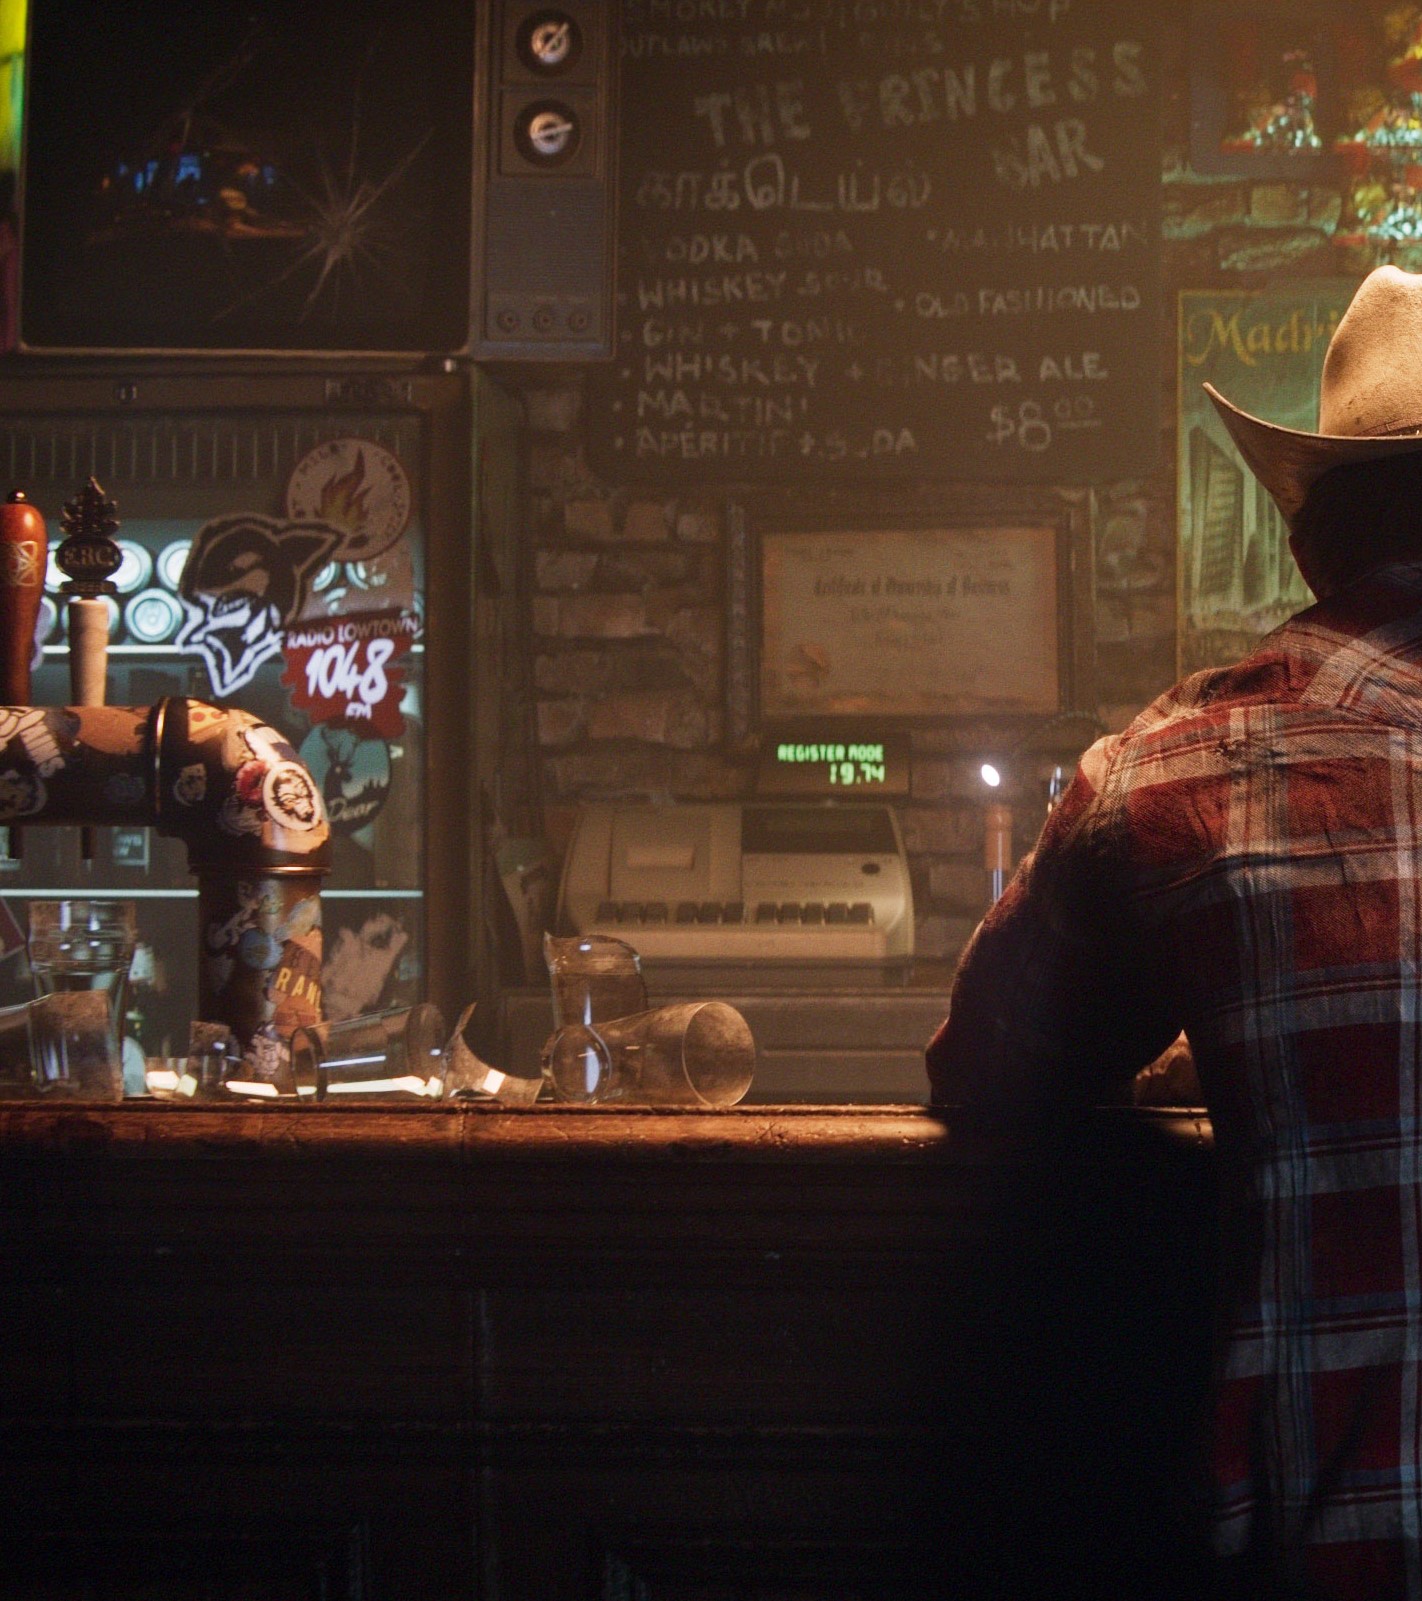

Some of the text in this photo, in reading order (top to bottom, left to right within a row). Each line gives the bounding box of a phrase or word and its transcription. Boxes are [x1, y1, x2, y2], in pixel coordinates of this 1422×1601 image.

[694, 78, 811, 148] THE
[637, 270, 787, 311] WHISKEY
[1038, 352, 1109, 382] ALE
[636, 388, 808, 427] MARTINI
[286, 616, 419, 649] RADIO LOWTOWN
[777, 744, 884, 763] REGISTER MODE
[829, 762, 886, 786] 19.74
